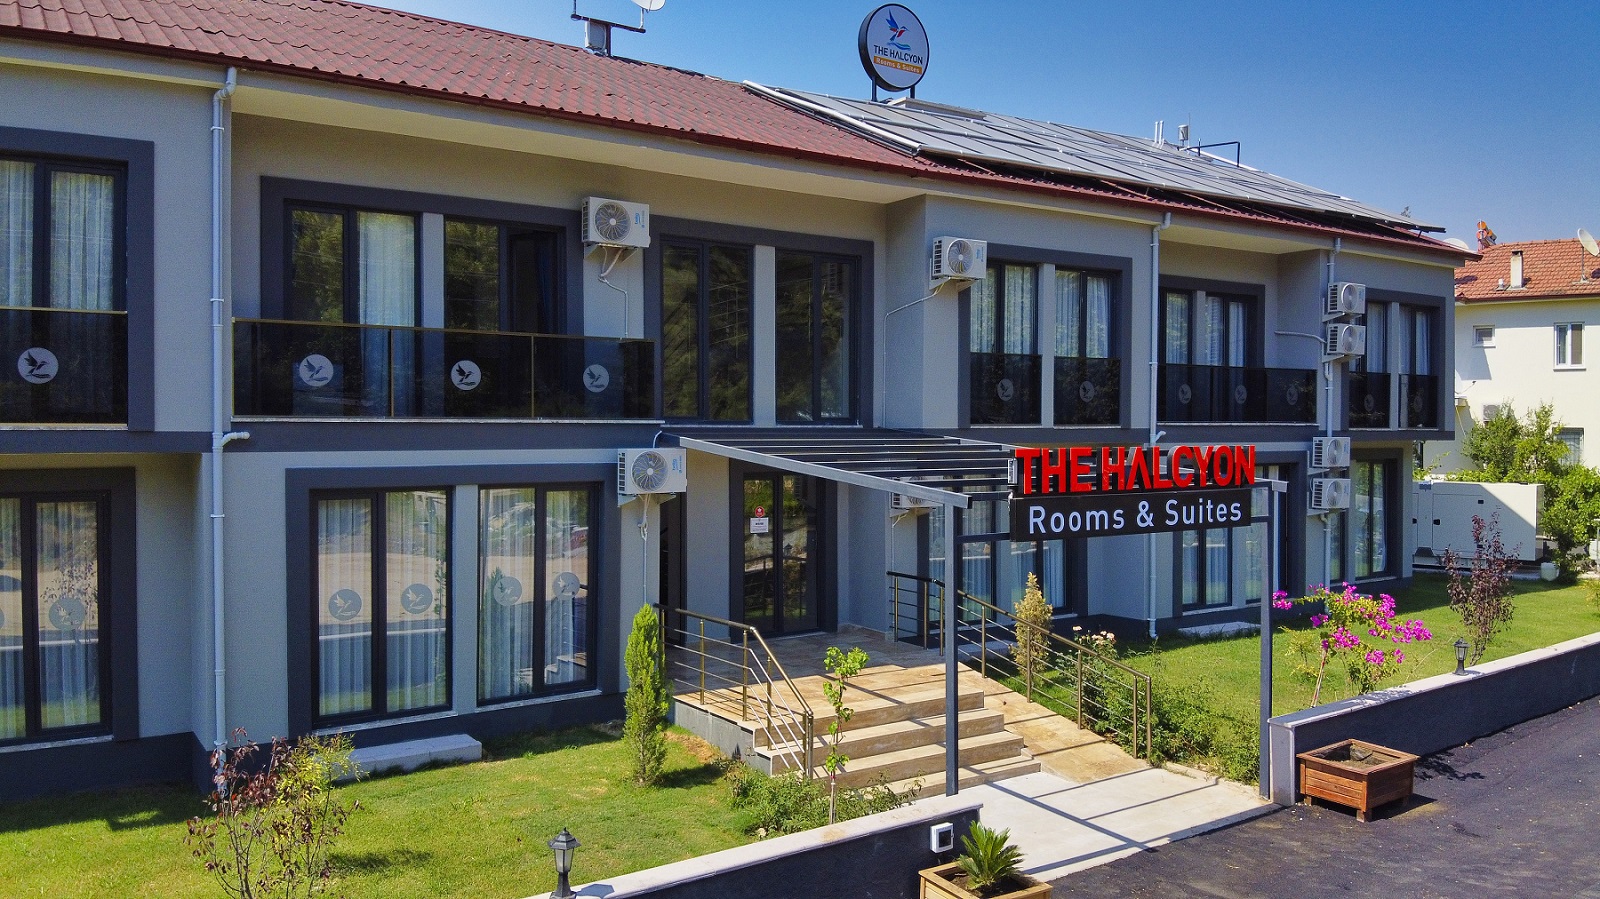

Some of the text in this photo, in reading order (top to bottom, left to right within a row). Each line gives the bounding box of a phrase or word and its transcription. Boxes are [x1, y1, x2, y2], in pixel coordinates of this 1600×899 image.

[874, 45, 923, 65] THE HALCYON
[876, 57, 895, 68] Rooms
[902, 64, 920, 73] Suites
[1015, 445, 1256, 494] THE HALCYON
[1029, 498, 1242, 534] Rooms & Suites
